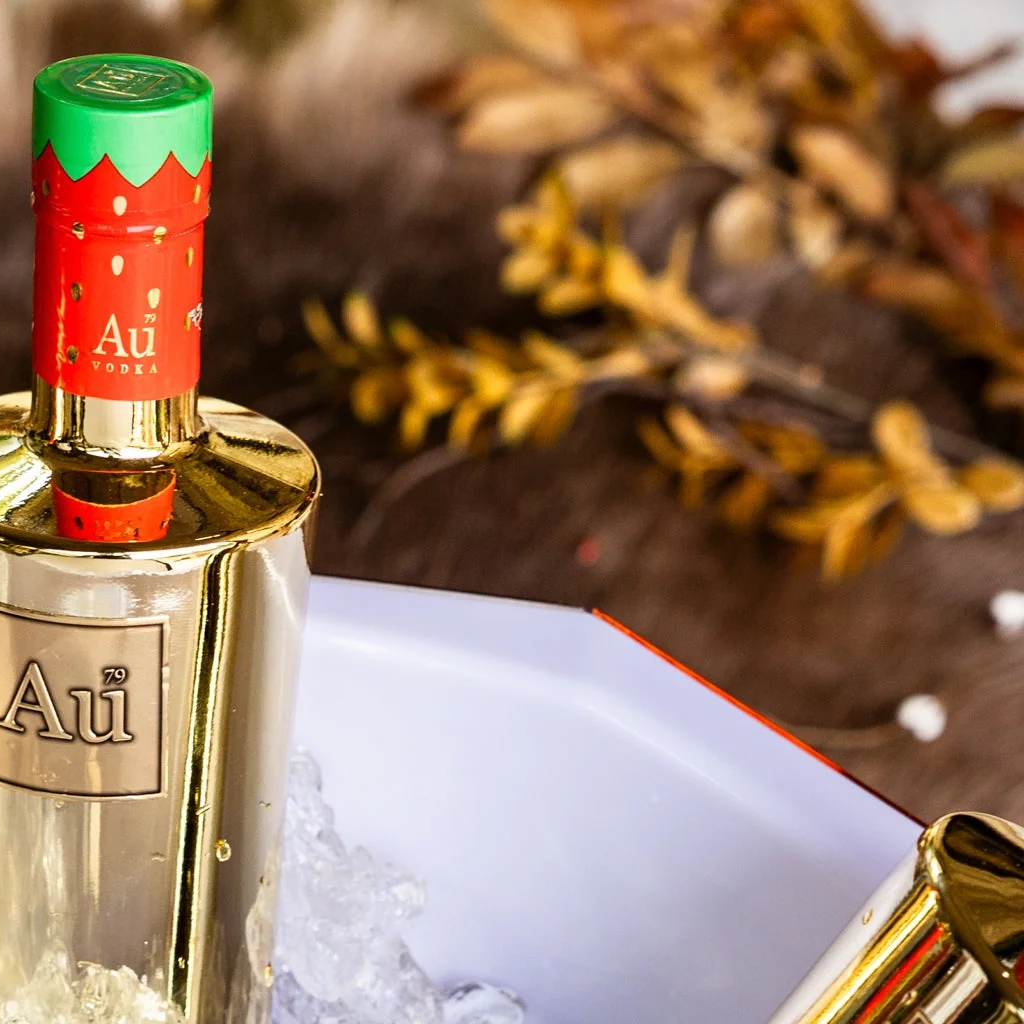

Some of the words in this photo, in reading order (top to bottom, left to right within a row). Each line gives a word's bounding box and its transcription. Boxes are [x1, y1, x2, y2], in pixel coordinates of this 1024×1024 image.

[92, 313, 157, 359] Au
[92, 361, 158, 375] VODKA
[103, 667, 127, 685] 79
